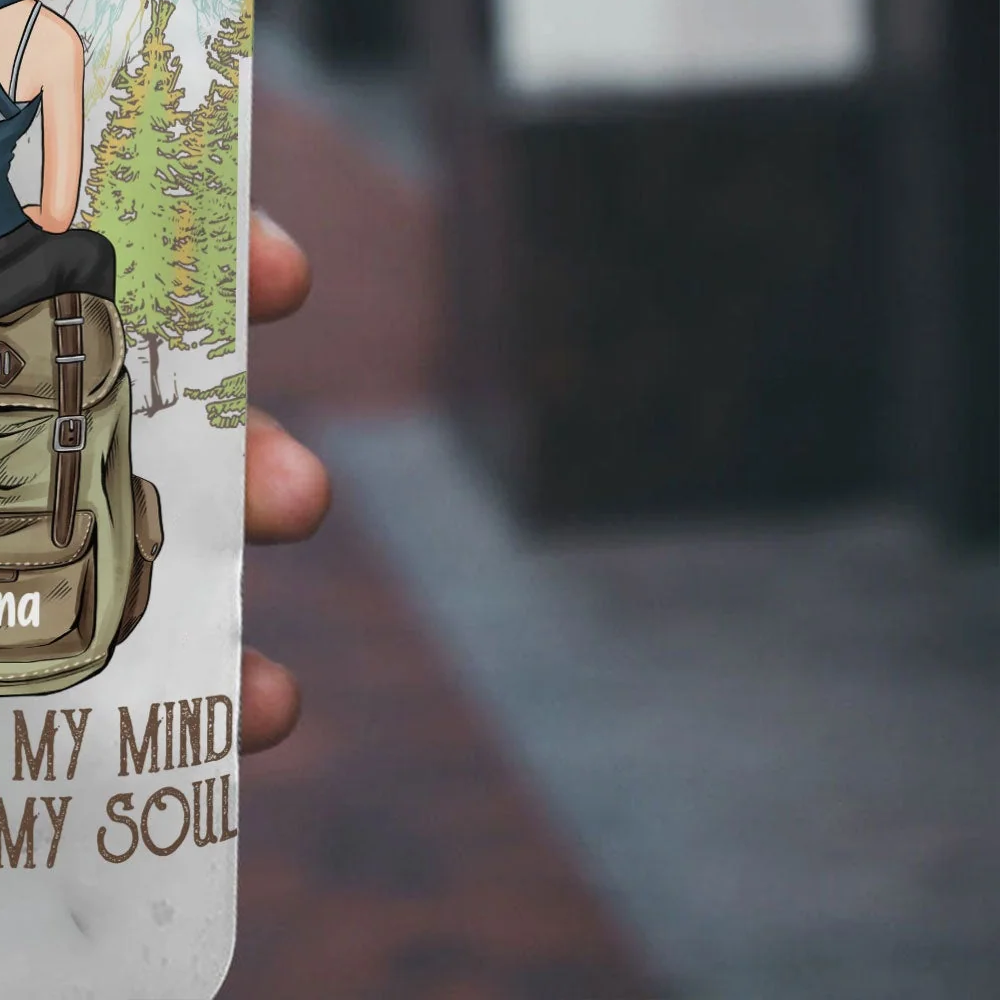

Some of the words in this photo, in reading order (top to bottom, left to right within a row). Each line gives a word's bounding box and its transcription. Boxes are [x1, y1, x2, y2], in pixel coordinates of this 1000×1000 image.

[12, 707, 93, 781] MY
[117, 694, 233, 777] MIND
[96, 773, 238, 864] SOUL
